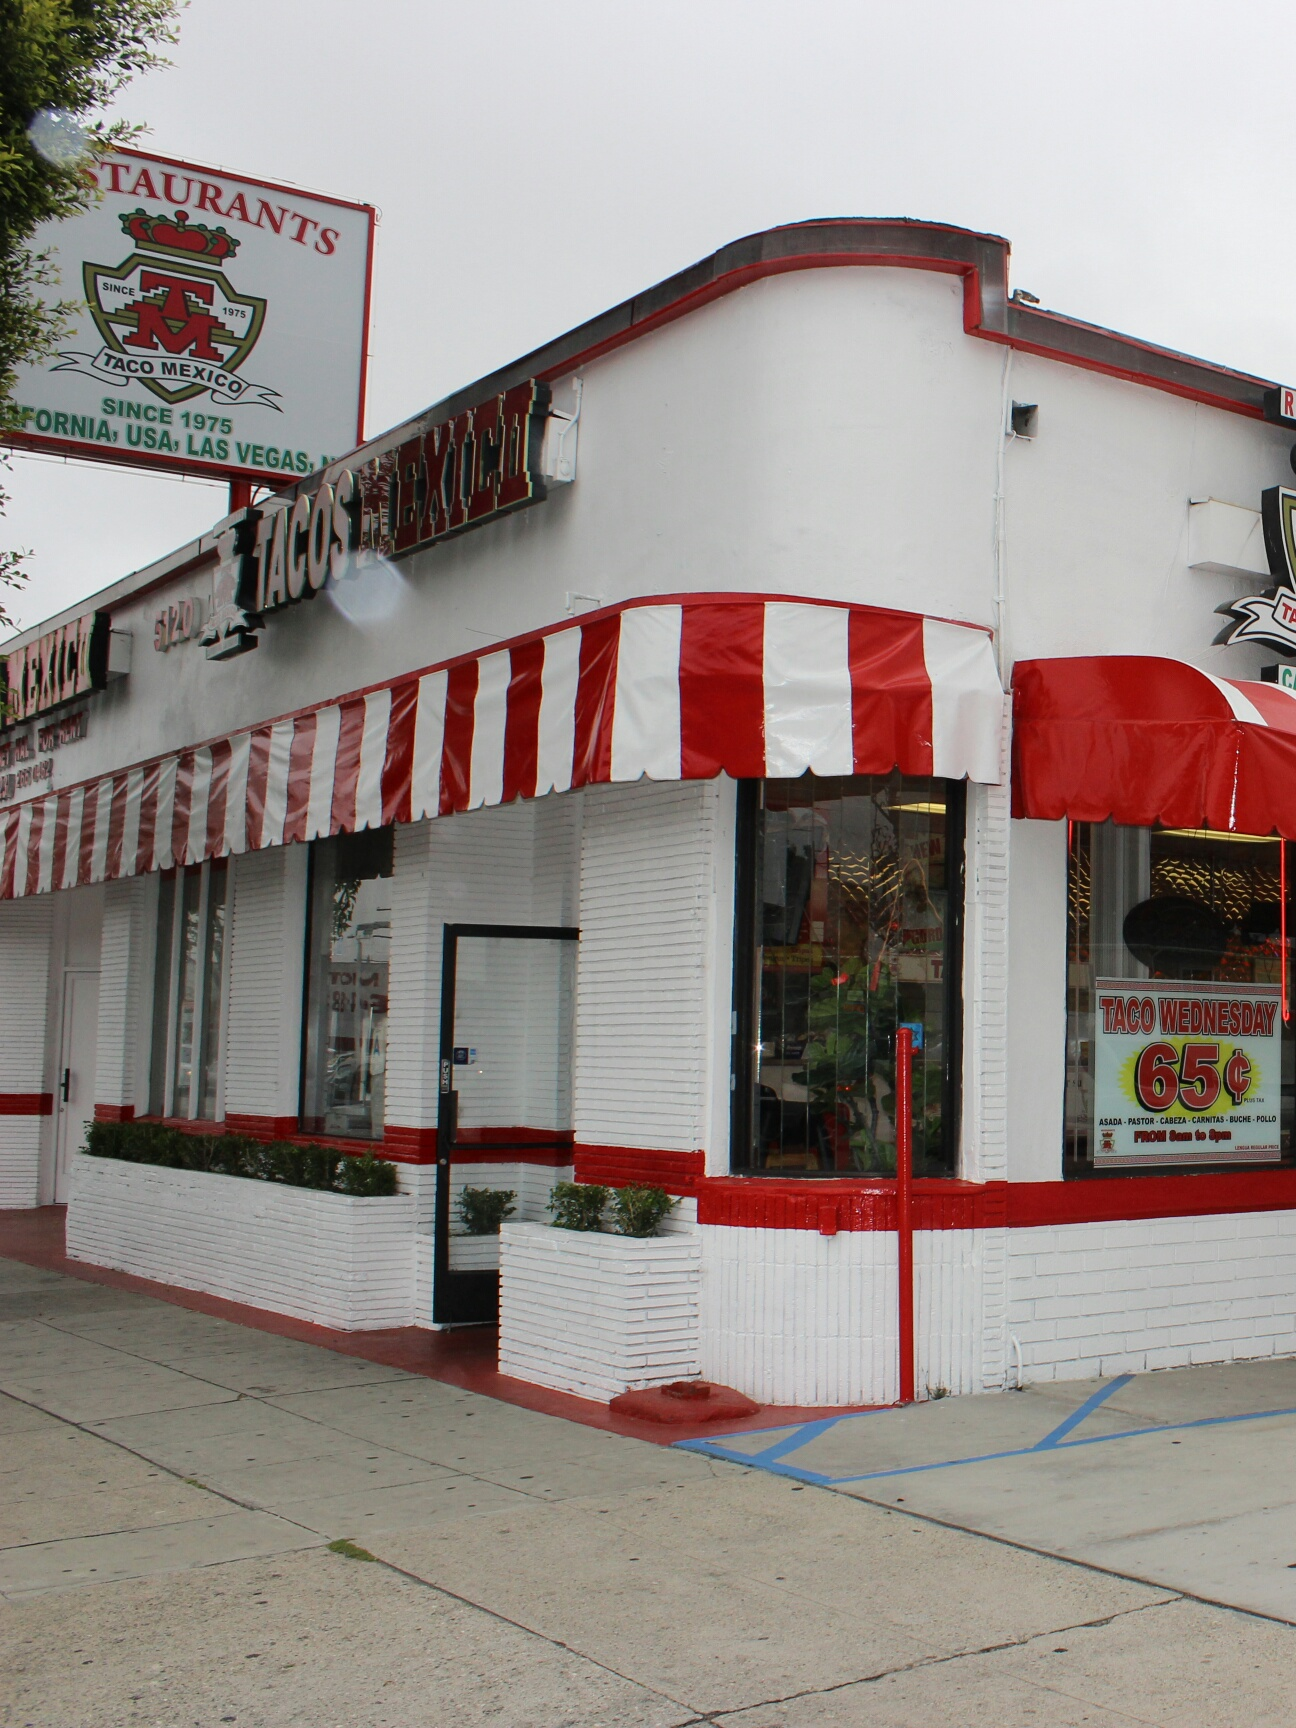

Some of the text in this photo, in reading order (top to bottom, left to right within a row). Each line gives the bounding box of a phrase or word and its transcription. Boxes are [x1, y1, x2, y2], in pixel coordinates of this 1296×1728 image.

[102, 282, 135, 297] SINCE
[222, 306, 247, 319] 1975
[103, 352, 243, 394] TACO MEXICO
[102, 397, 233, 435] SINCE 1975
[187, 434, 230, 462] LAS
[256, 378, 536, 613] TACOS MEXICO
[1099, 995, 1279, 1037] TACO WEDNESDAY
[1098, 1115, 1277, 1126] ASADA PASTOR CABEZA CARNITAS BUCHE POLLO
[1134, 1130, 1167, 1143] FROM
[1195, 1128, 1207, 1141] to
